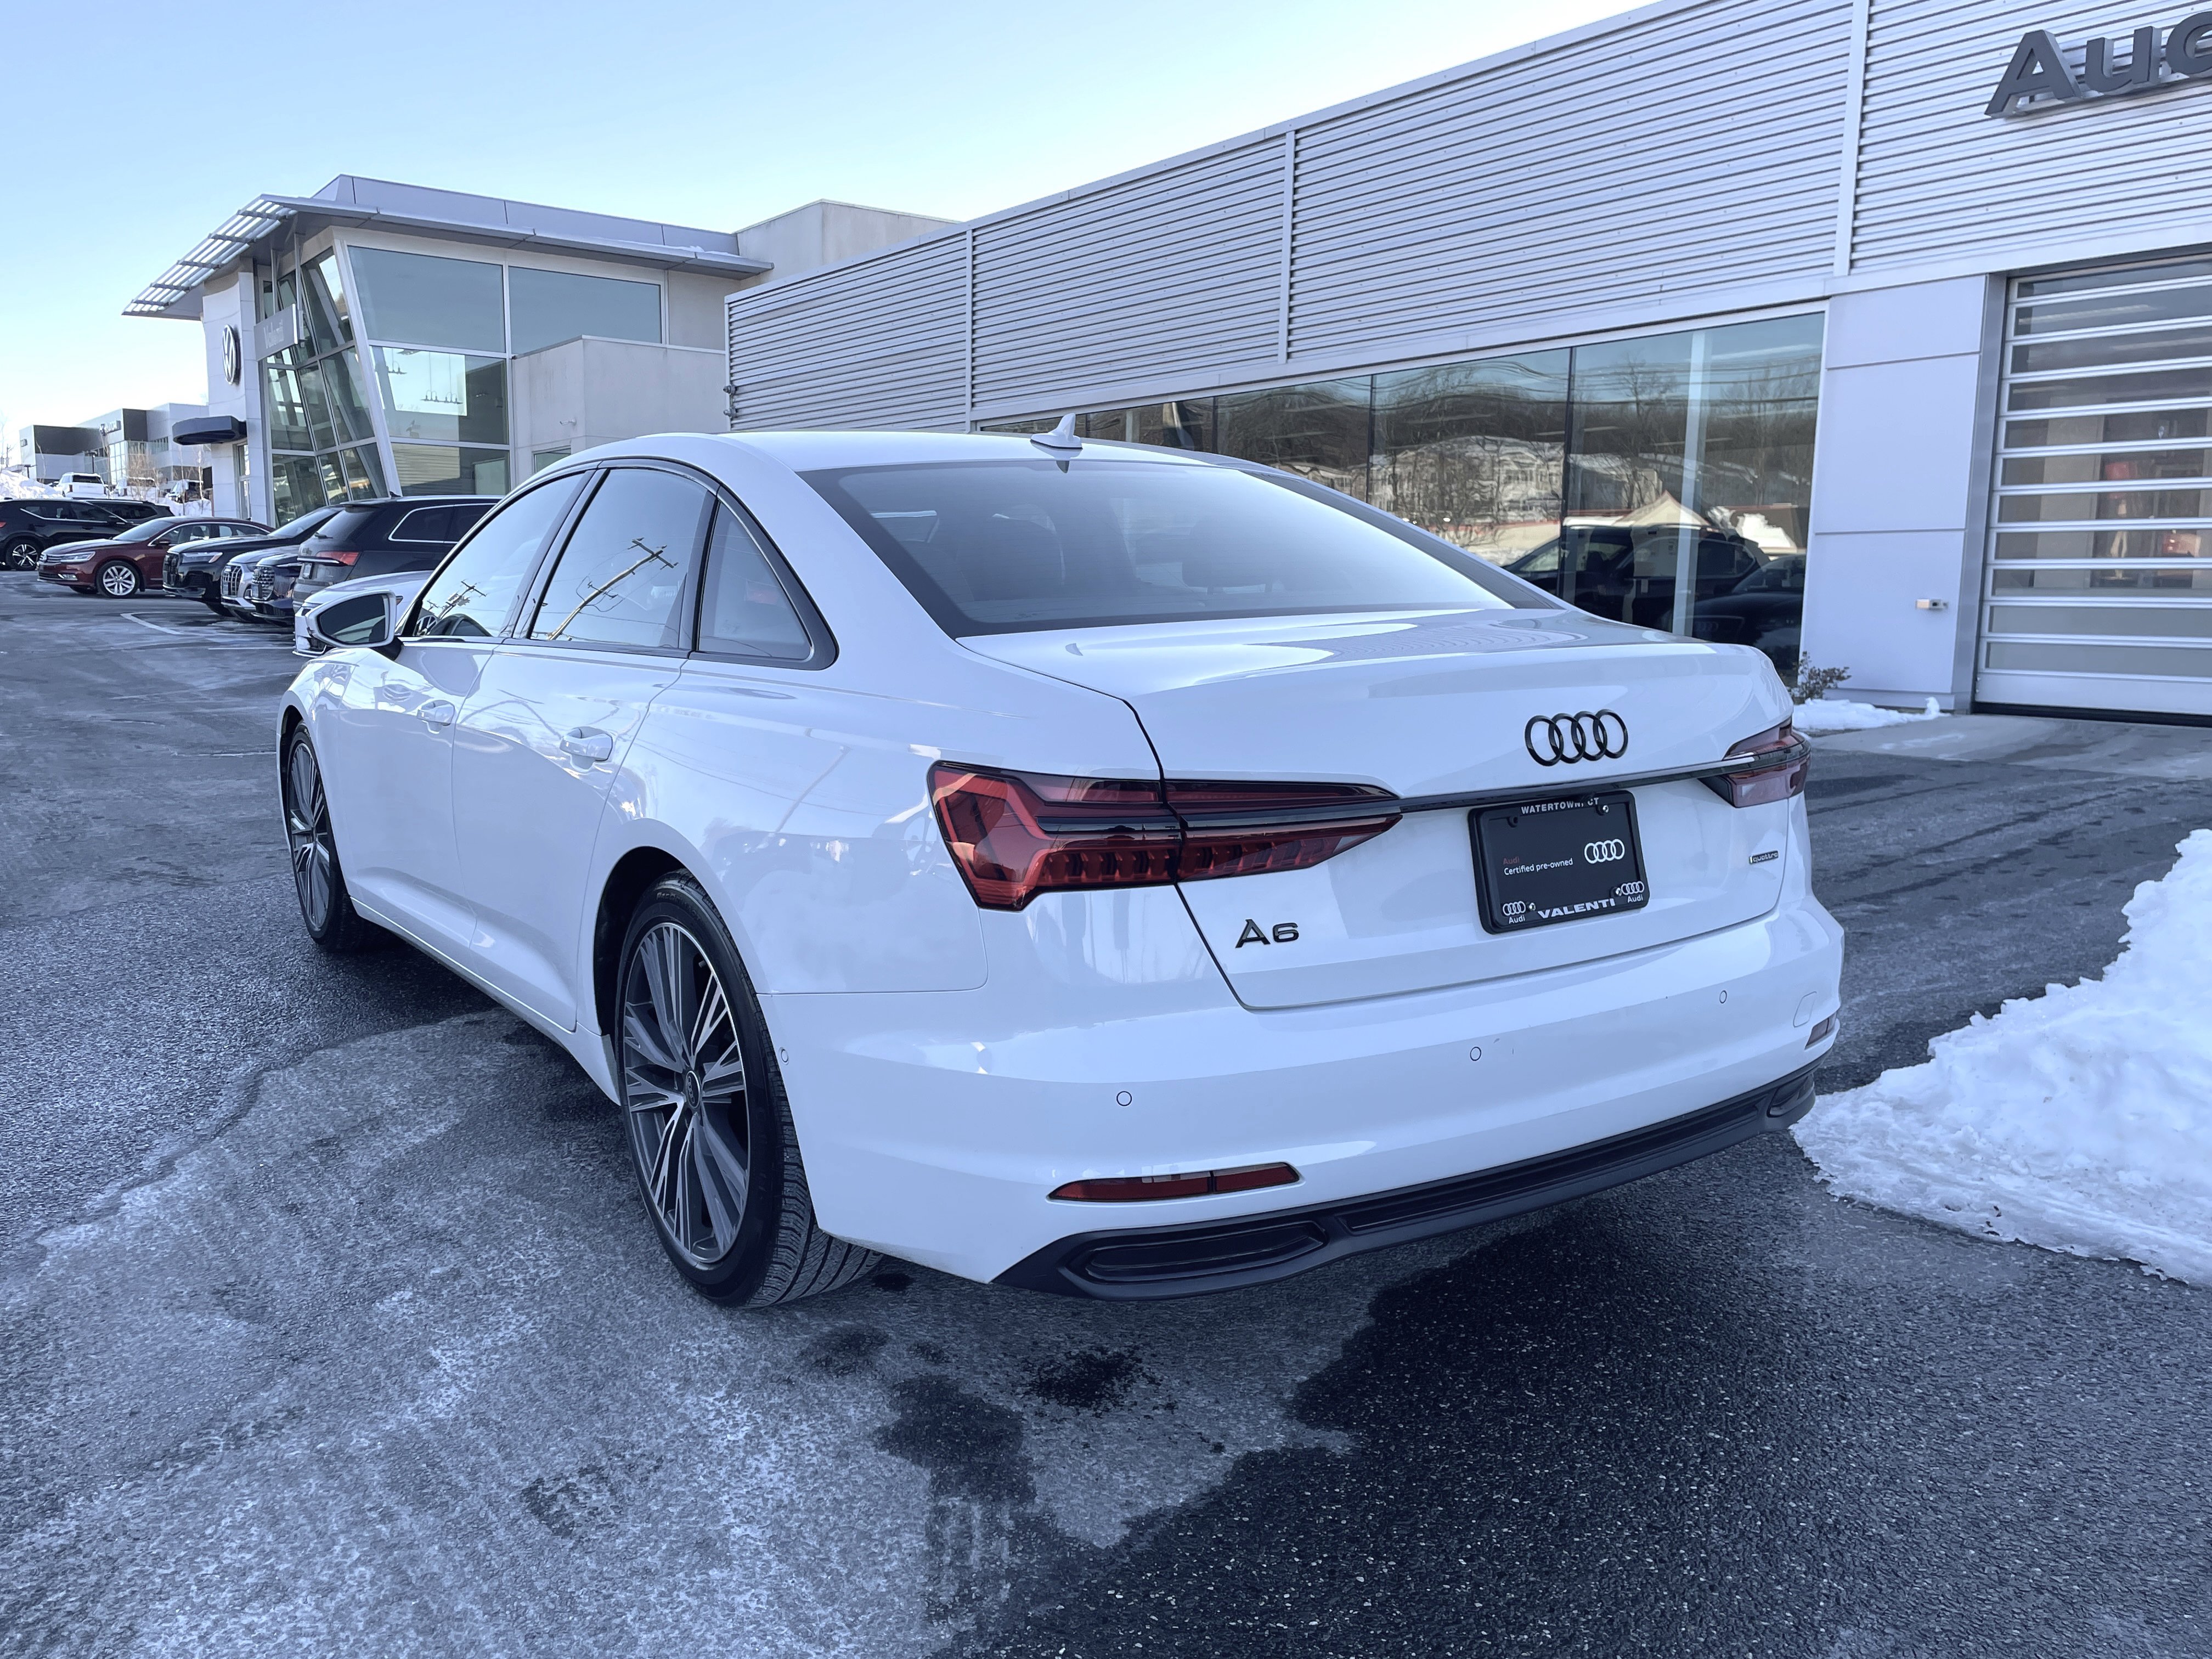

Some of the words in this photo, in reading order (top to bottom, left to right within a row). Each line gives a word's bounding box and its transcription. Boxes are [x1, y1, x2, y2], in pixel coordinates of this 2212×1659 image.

[1503, 856, 1520, 865] Audi
[1752, 852, 1778, 863] quattro
[1504, 864, 1534, 876] Certified
[1536, 857, 1573, 872] pre-owned
[1627, 894, 1643, 903] Audi
[1538, 898, 1615, 918] VALENTI
[1509, 915, 1525, 924] Audi
[1235, 918, 1299, 948] A6
